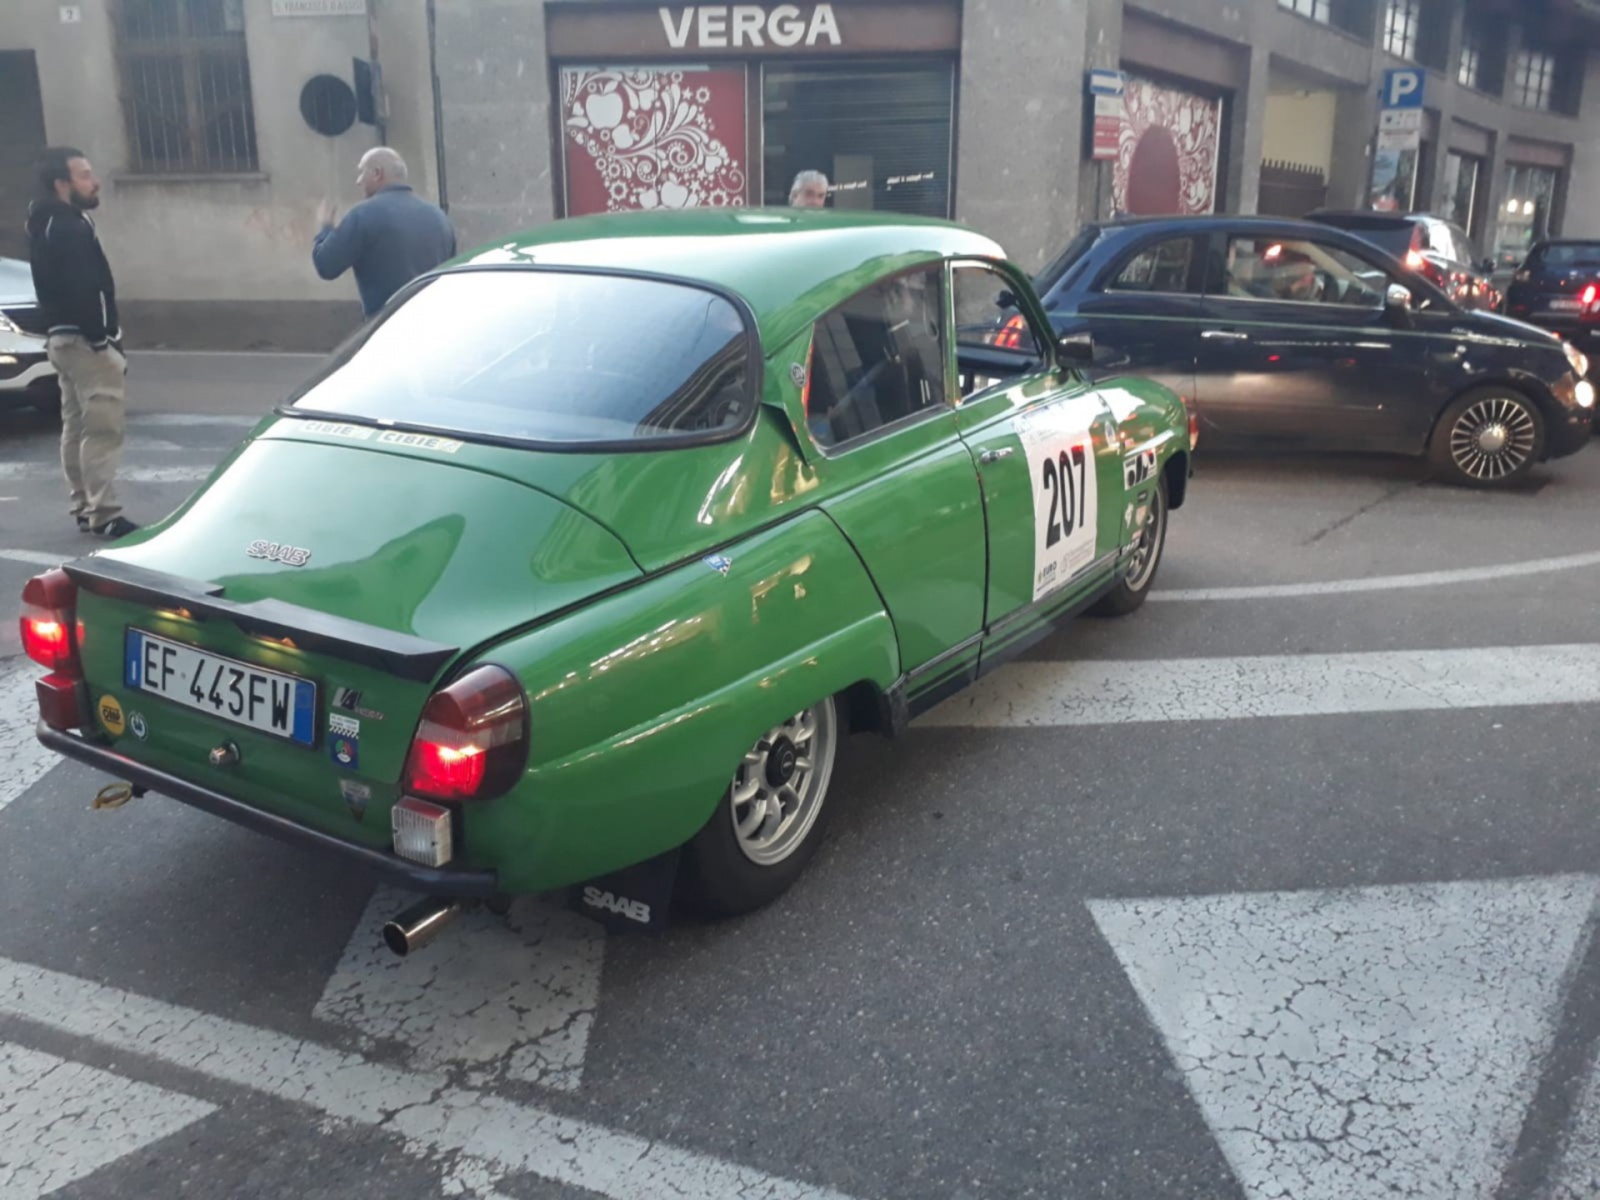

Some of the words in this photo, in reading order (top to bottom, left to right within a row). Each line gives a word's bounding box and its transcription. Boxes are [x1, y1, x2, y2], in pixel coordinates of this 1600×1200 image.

[659, 4, 841, 47] VERGA
[1390, 72, 1418, 105] P
[305, 420, 356, 436] CIBIE
[382, 432, 439, 448] CIBIE
[1042, 445, 1086, 550] 207
[247, 540, 312, 567] SAAB
[189, 658, 294, 732] 443FW
[582, 886, 651, 923] SAAB
